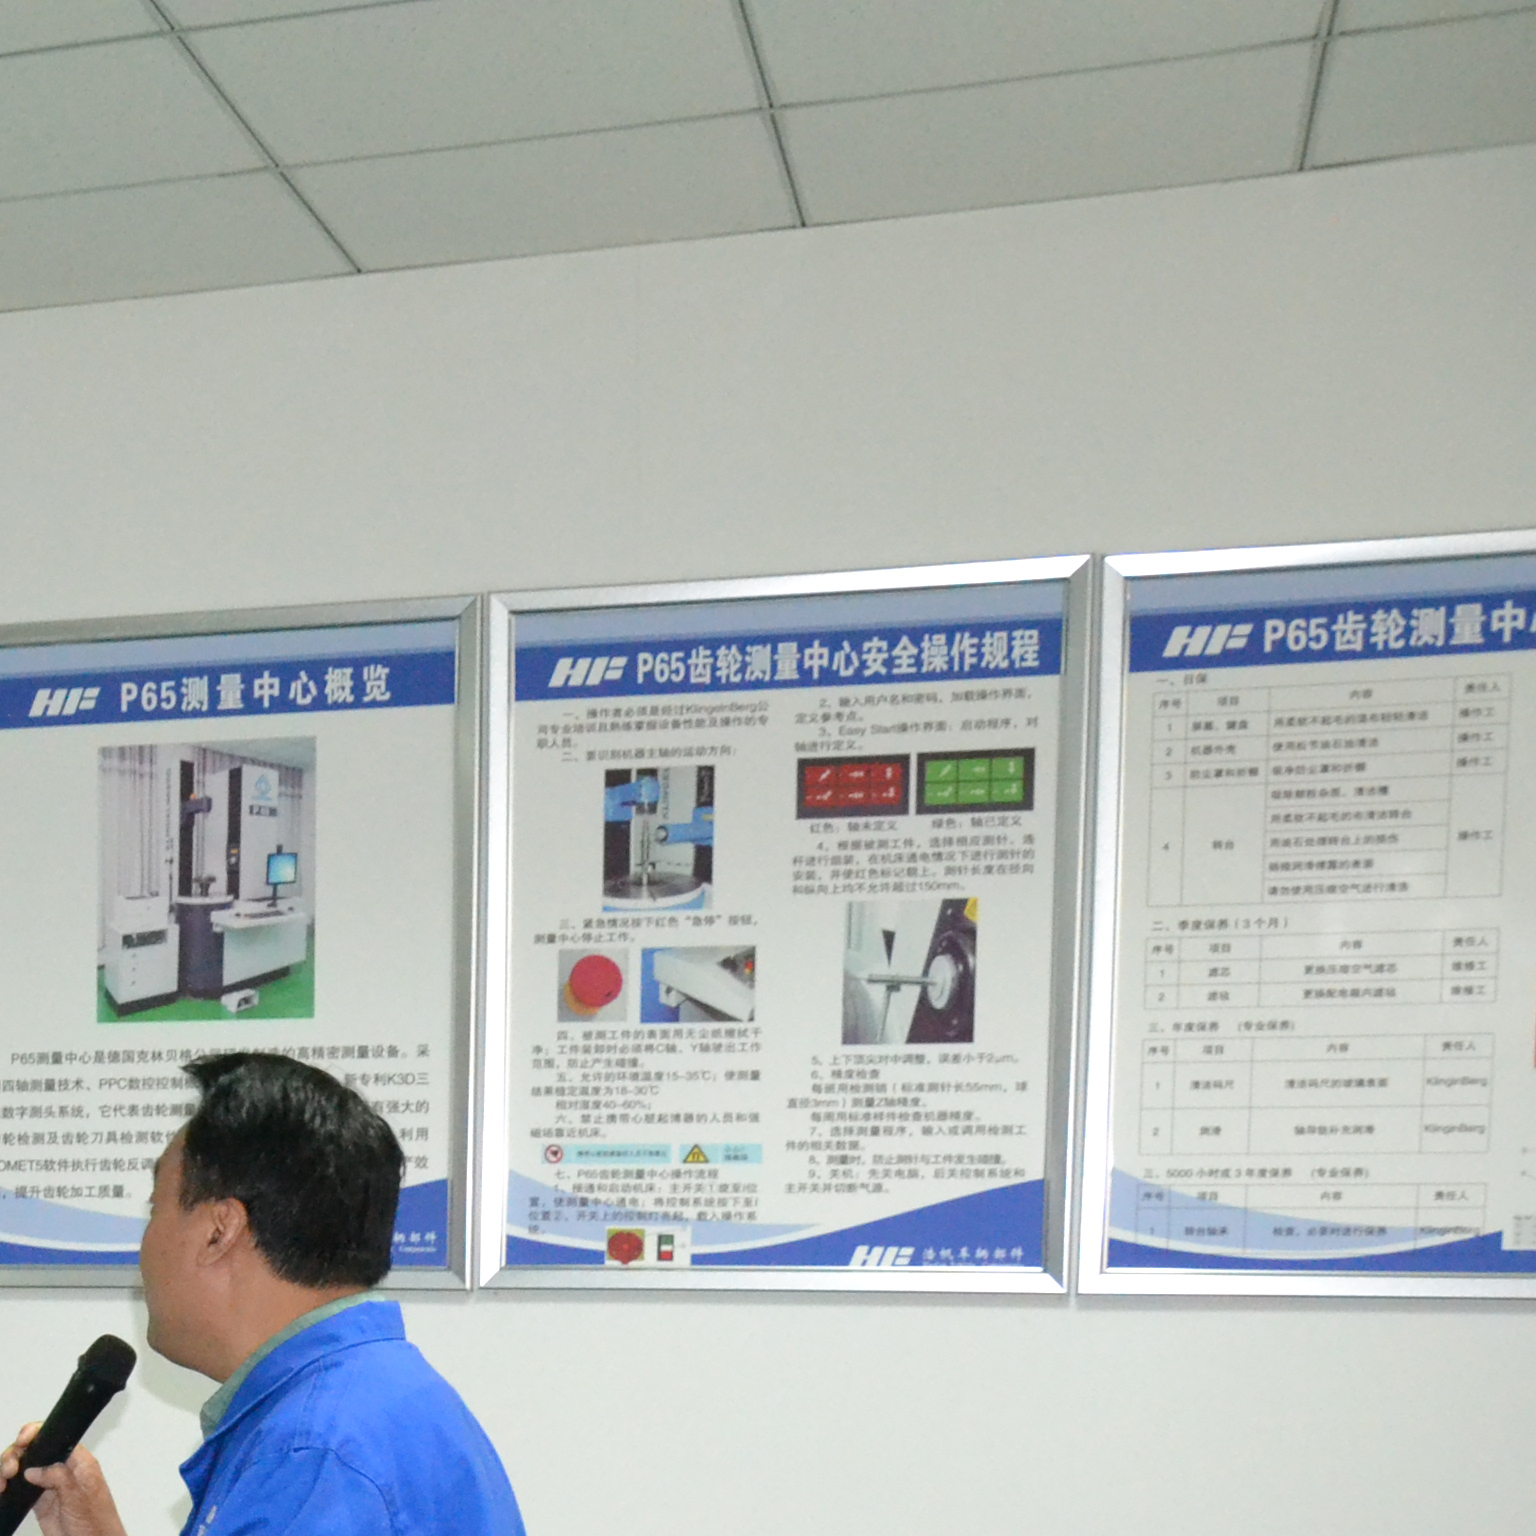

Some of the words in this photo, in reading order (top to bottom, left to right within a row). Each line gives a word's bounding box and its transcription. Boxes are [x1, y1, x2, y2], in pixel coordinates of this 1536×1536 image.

[1262, 598, 1536, 653] P65齿轮测量中
[636, 628, 1041, 684] P65齿轮测量中心安全操作规程
[120, 664, 392, 712] P65测量中心概览
